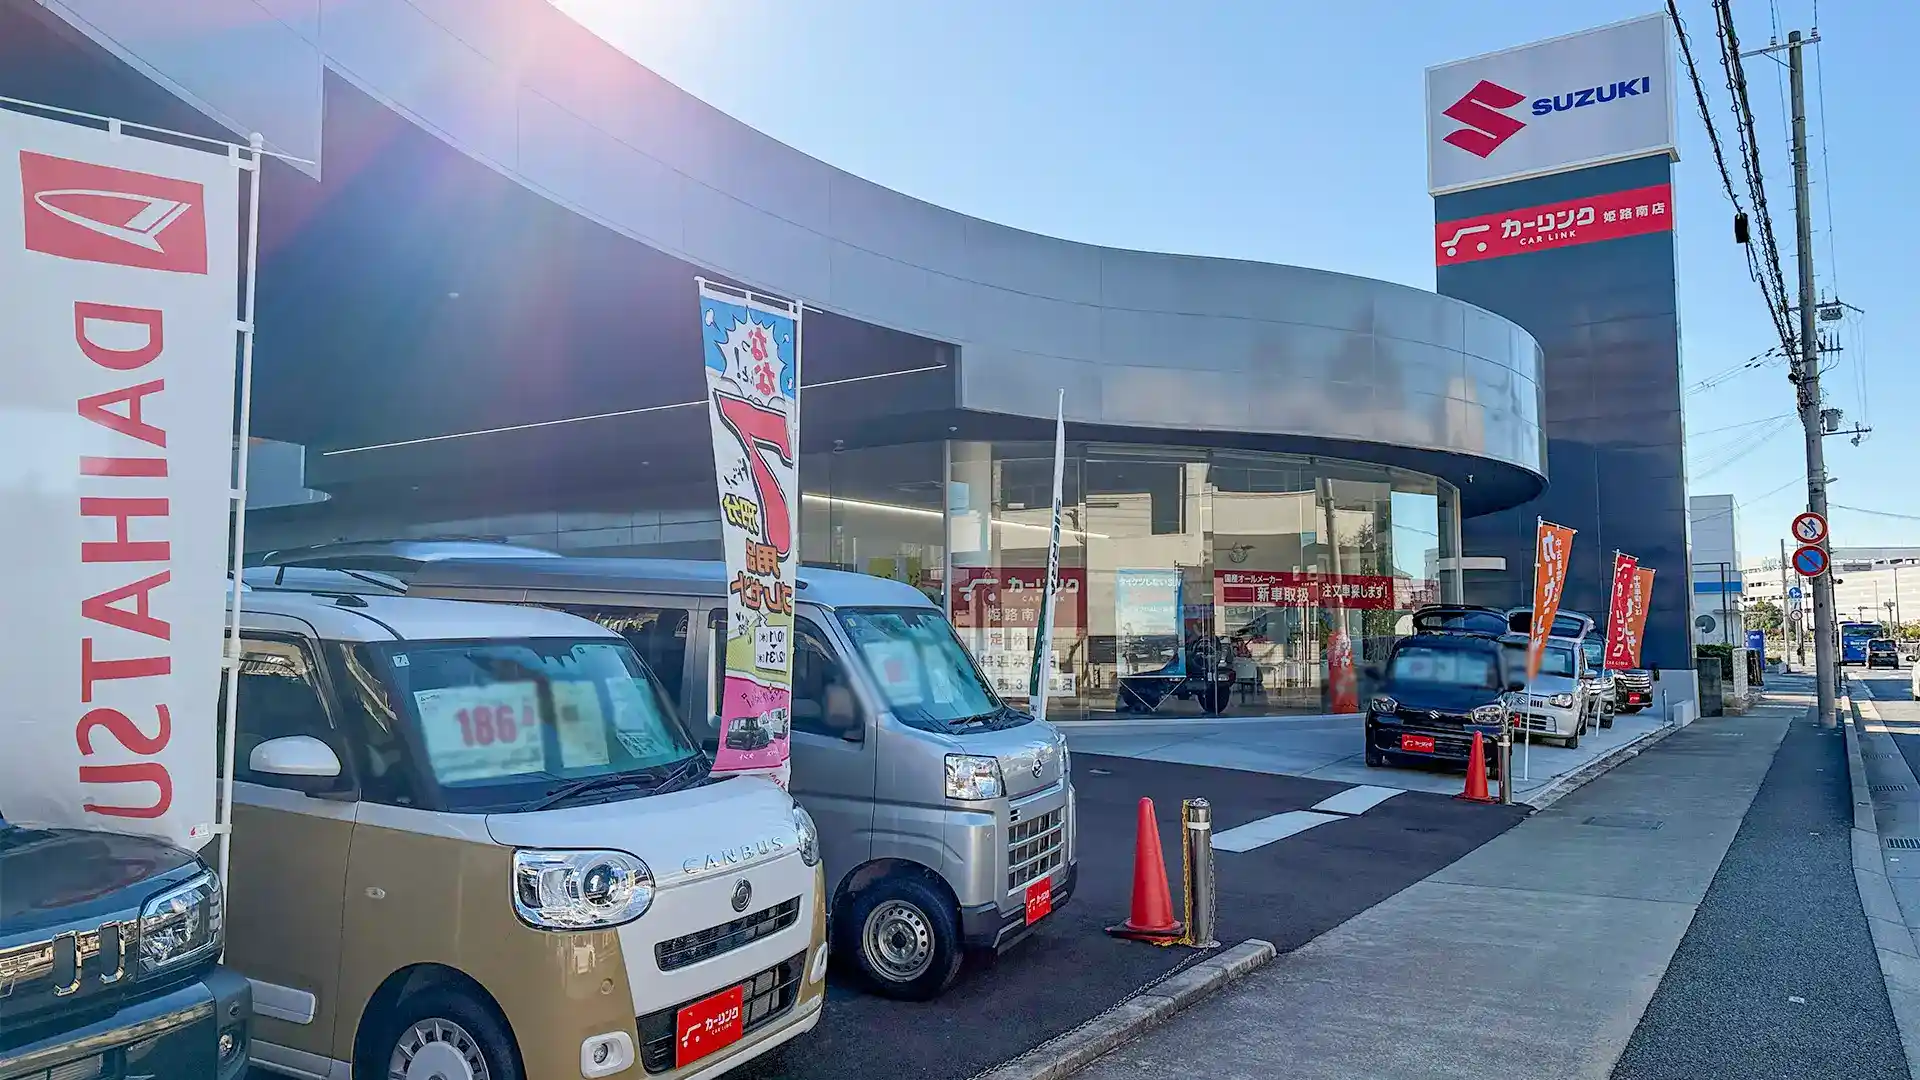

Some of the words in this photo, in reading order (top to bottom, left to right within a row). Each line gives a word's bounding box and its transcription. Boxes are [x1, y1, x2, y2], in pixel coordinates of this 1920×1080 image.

[1531, 76, 1650, 116] SUZUKI
[1501, 206, 1596, 239] カーリンク
[1603, 202, 1665, 223] 姫路南店
[1519, 235, 1543, 246] CAR
[1548, 229, 1577, 241] LINK
[1224, 574, 1282, 584] 国産オールメーカー
[1257, 585, 1309, 602] 新車取扱
[988, 607, 1035, 622] 姫路南
[990, 632, 1027, 646] 定休
[455, 705, 517, 748] 186
[683, 836, 784, 874] CANBUS
[705, 1007, 738, 1032] カーリンク
